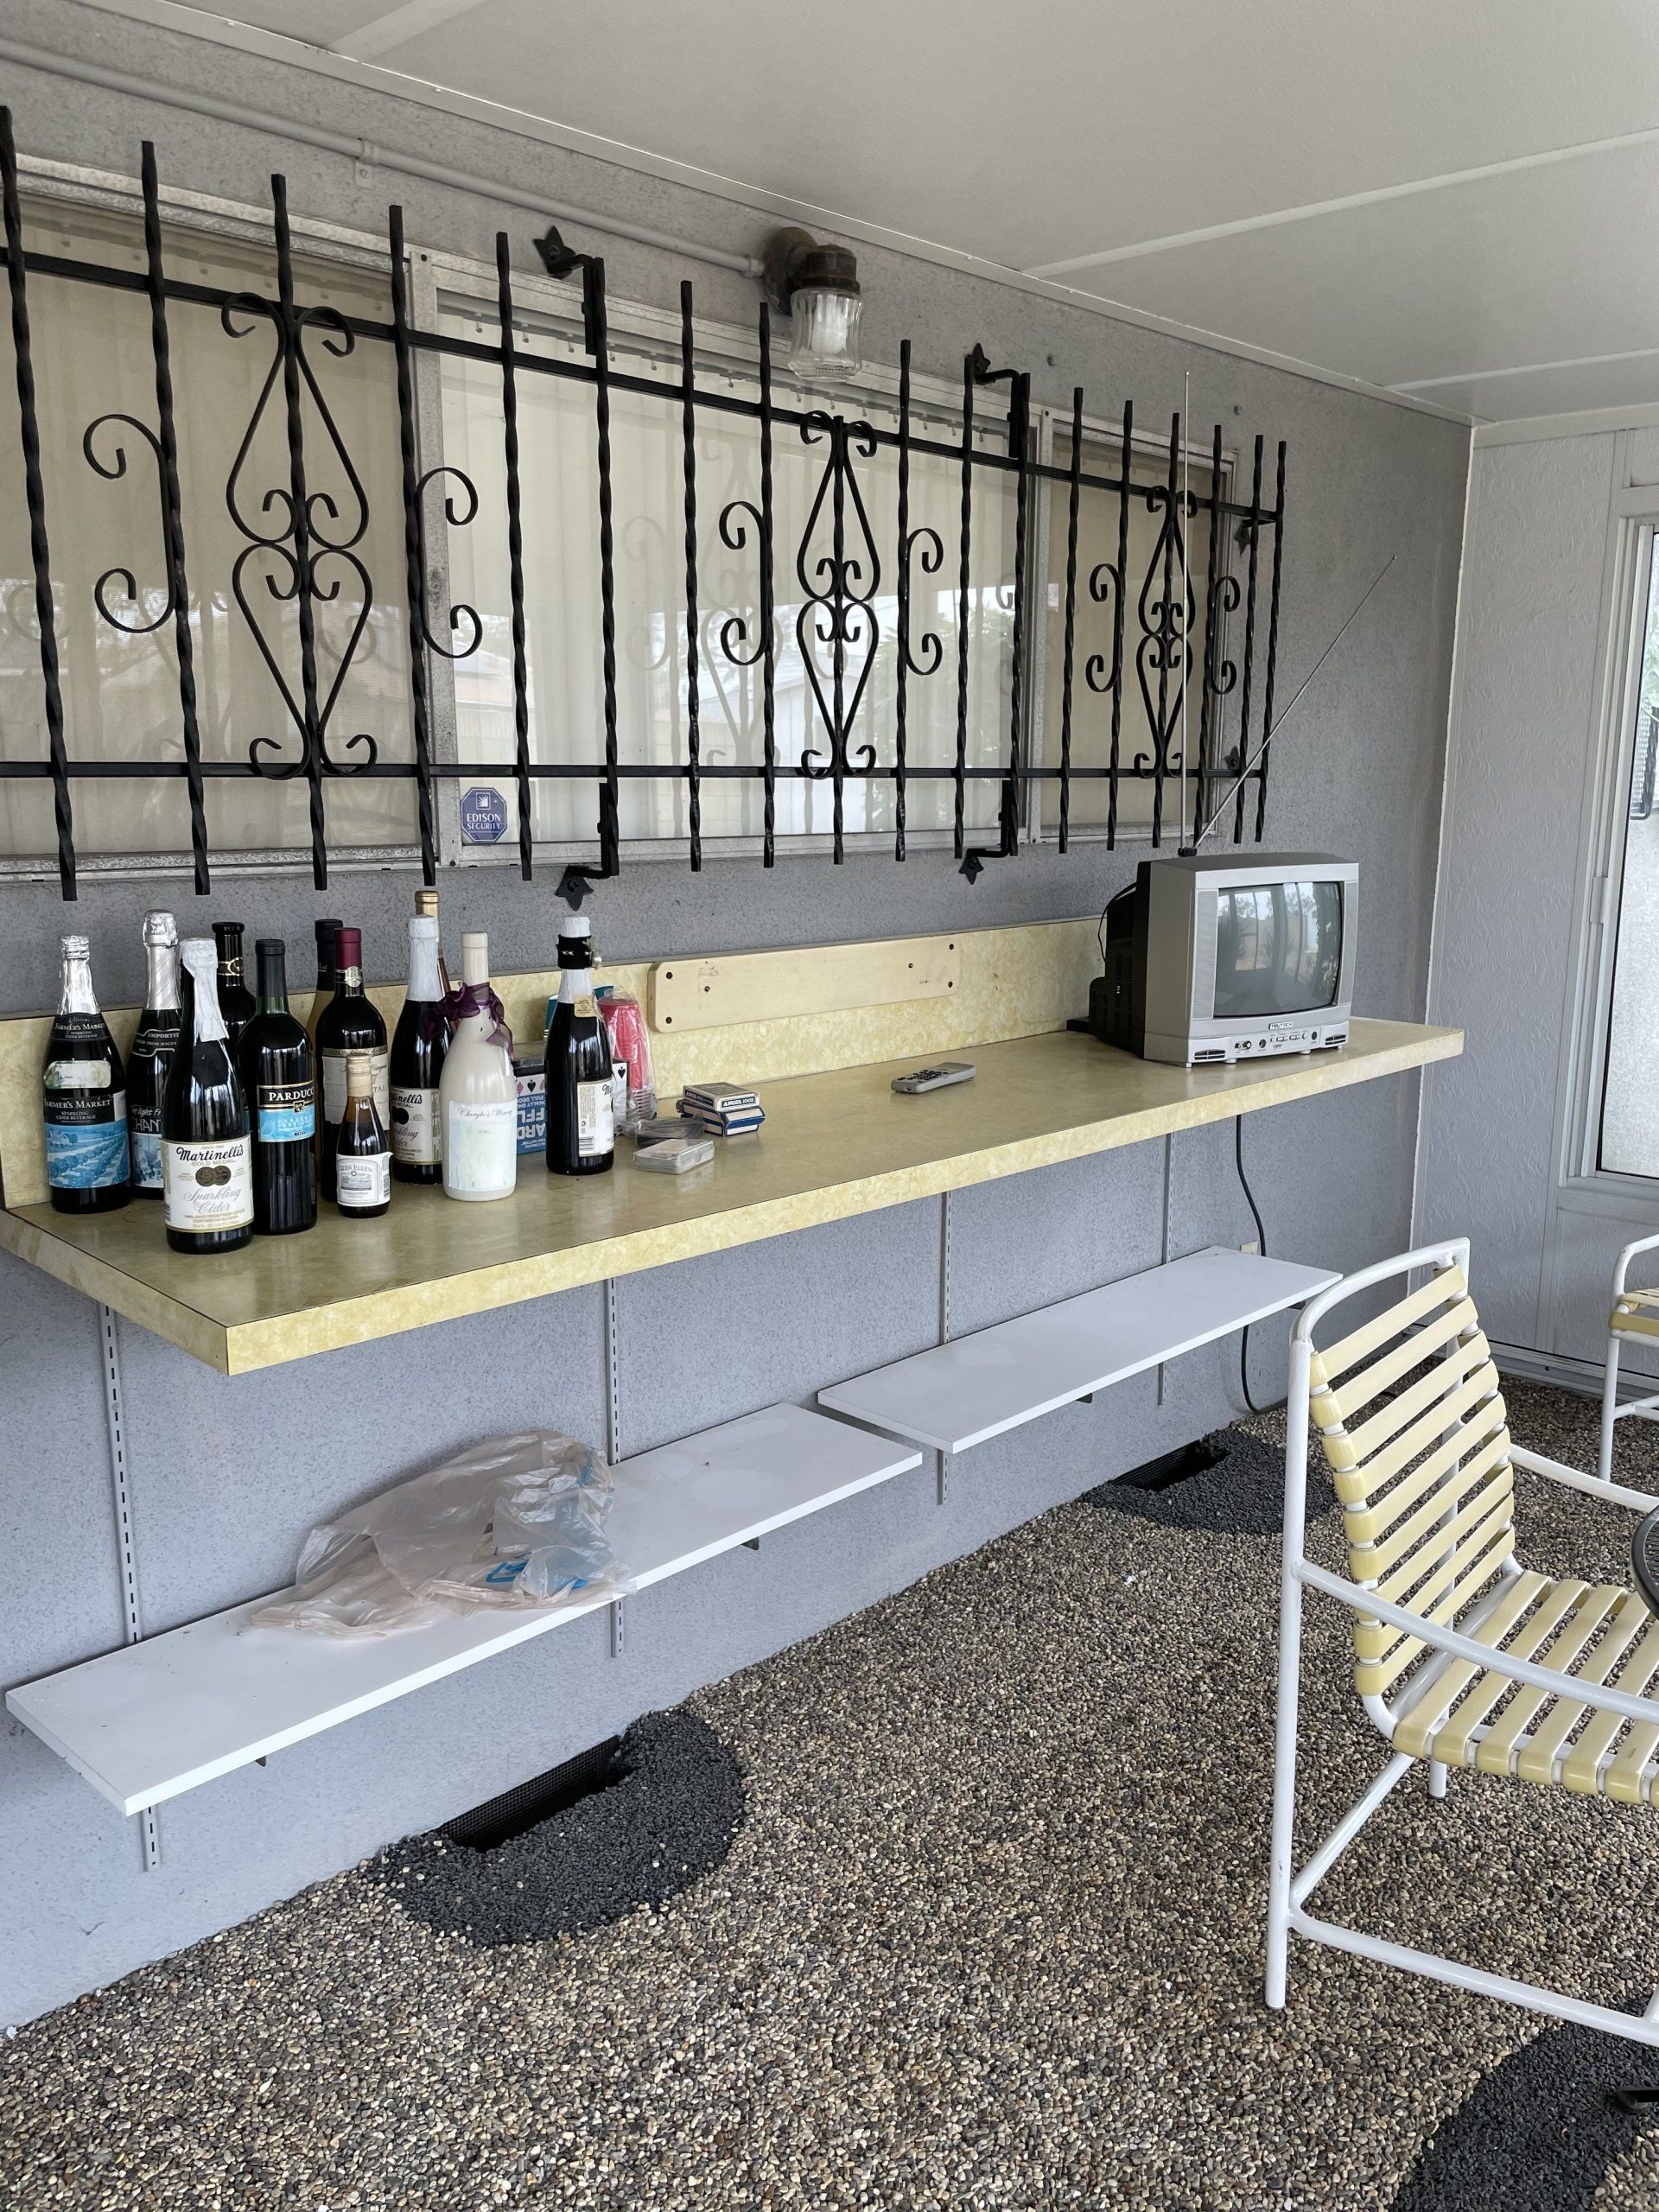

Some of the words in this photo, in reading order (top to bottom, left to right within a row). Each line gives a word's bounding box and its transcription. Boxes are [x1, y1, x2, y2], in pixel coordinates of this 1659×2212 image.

[467, 813, 501, 823] EDISON
[54, 1022, 81, 1031] FARMER'S
[82, 1022, 105, 1031] MARKET
[373, 1084, 386, 1094] TAL
[75, 1098, 111, 1109] MARKET
[517, 1107, 545, 1123] FFL
[517, 1122, 546, 1141] ARD
[176, 1144, 244, 1161] Martinelli's
[183, 1185, 242, 1204] Sparkling
[193, 1201, 231, 1214] Cider
